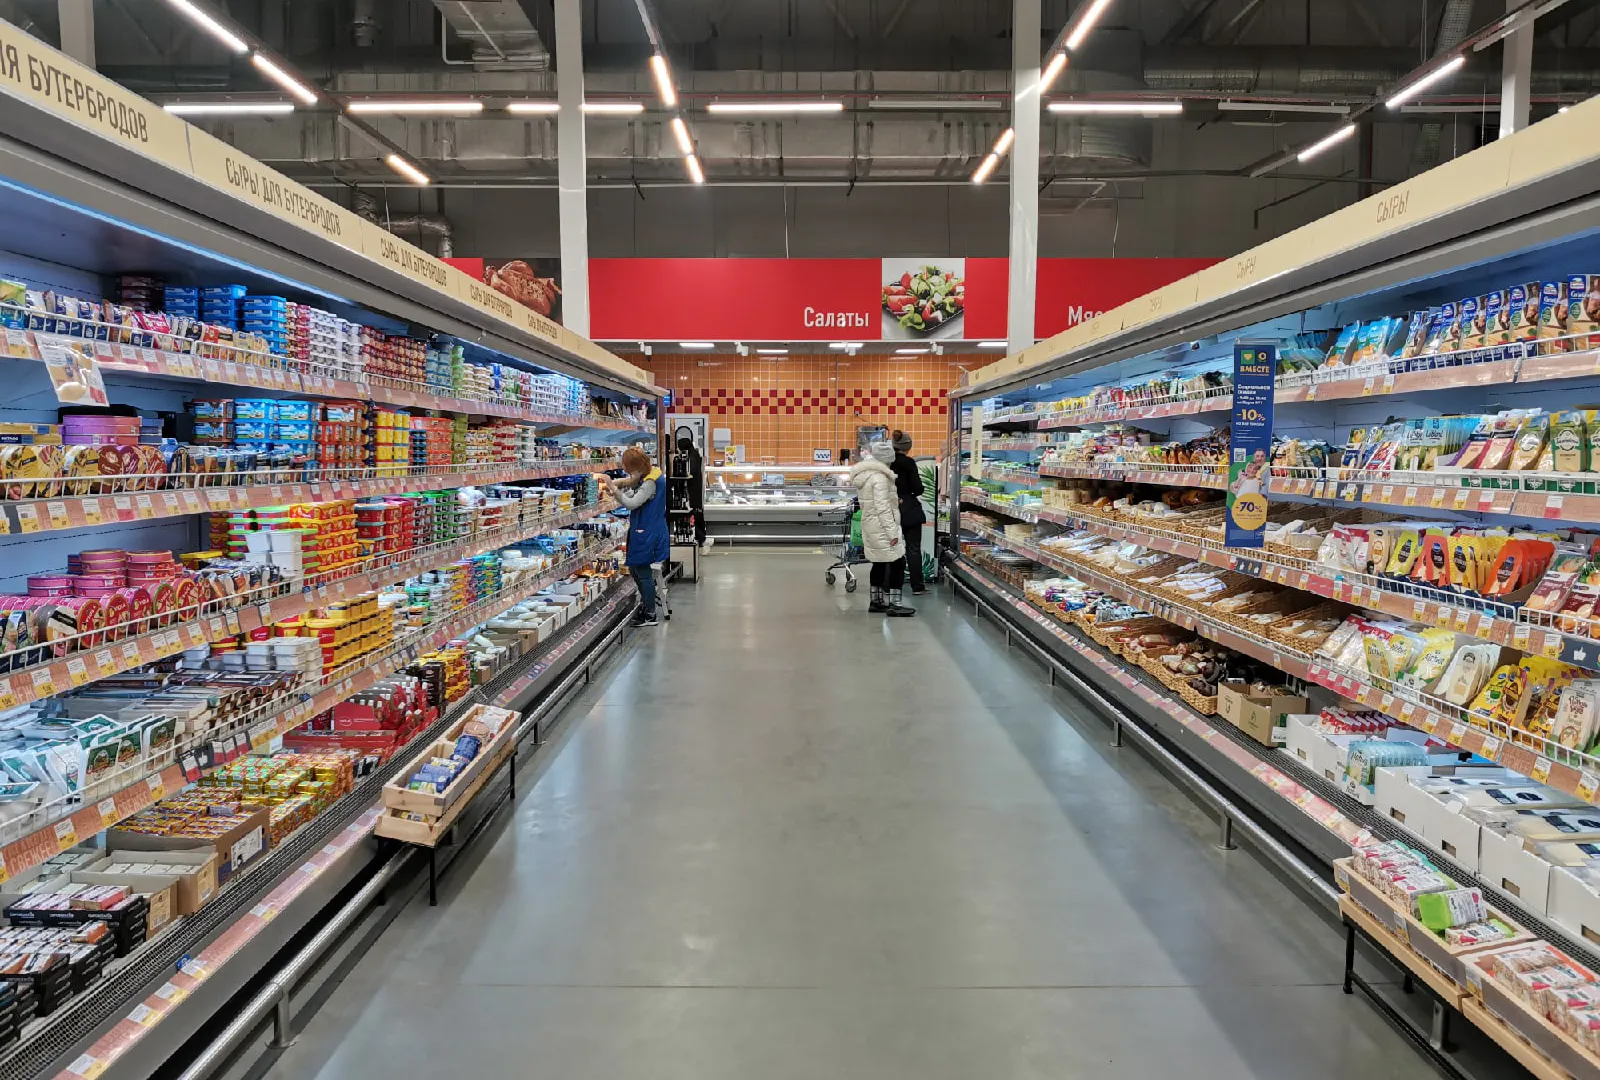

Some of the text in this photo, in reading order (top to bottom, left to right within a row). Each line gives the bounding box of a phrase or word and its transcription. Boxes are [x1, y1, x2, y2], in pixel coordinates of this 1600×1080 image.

[27, 53, 149, 143] БУТЕРБРОДОВ
[225, 157, 341, 236] СЫРЫ ДЛЯ БУТЕРБРОДОВ
[1376, 189, 1410, 224] СЫРЫ
[380, 238, 401, 265] СЫРЫ
[803, 306, 870, 328] Салаты
[1239, 365, 1271, 374] ВМЕСТЕ
